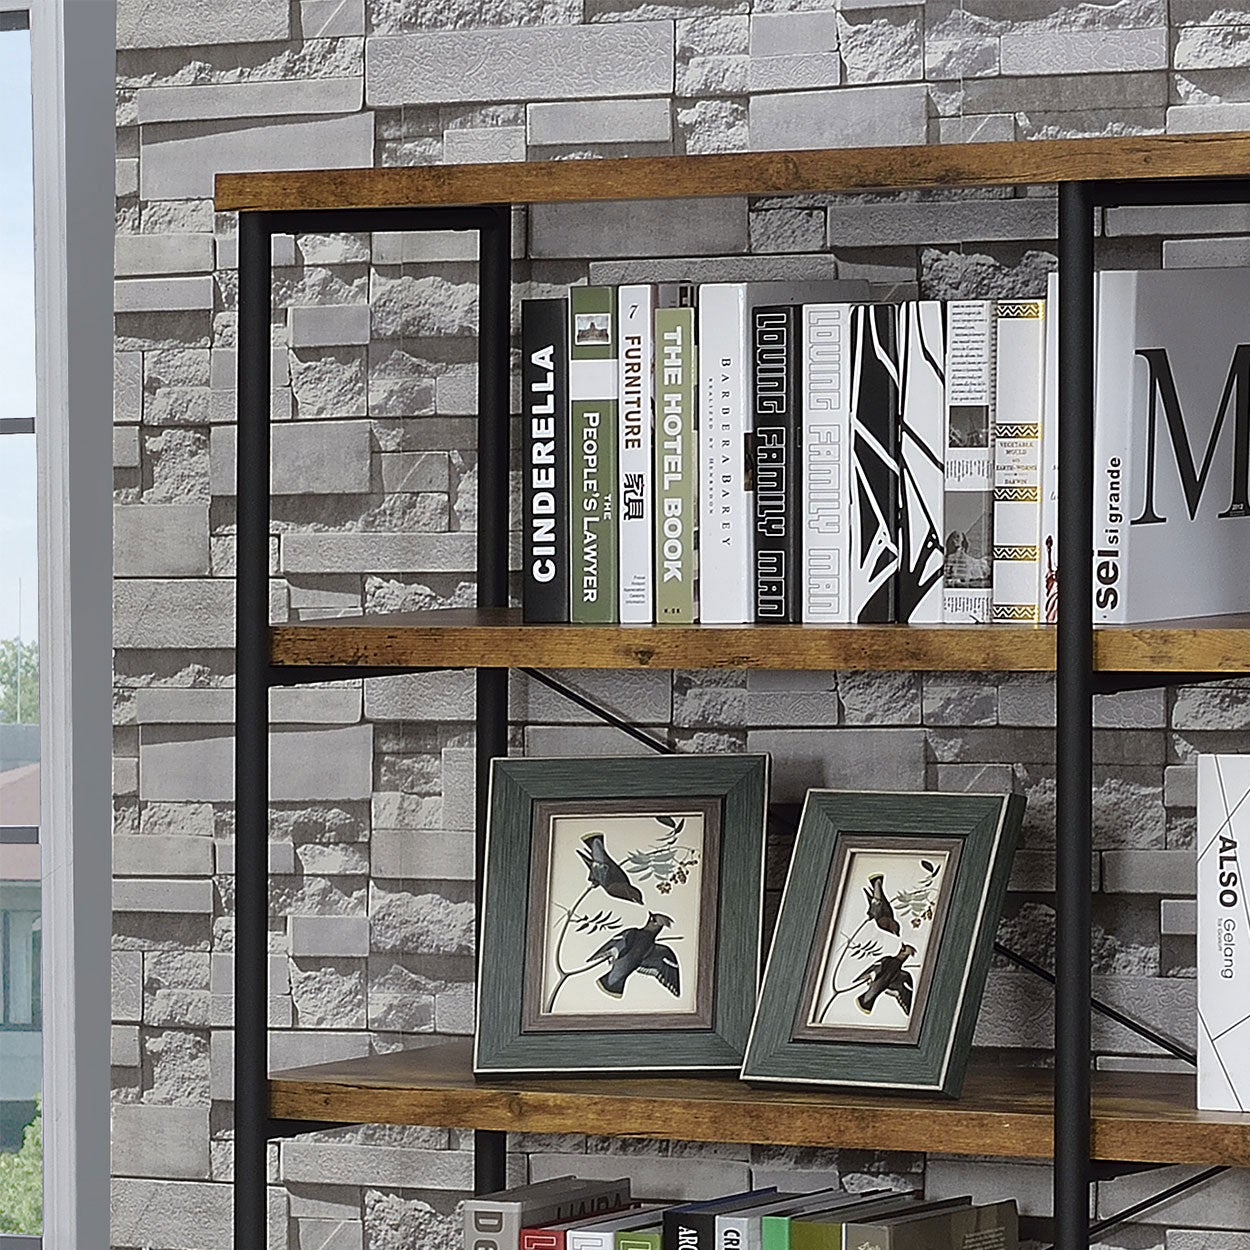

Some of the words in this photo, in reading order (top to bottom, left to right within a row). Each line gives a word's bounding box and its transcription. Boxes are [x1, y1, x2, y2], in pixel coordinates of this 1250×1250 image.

[624, 335, 641, 450] FURNITURE
[663, 325, 683, 386] THE
[530, 344, 556, 583] CINDERELLA
[582, 412, 601, 511] PEOPLE'S
[663, 393, 683, 491] HOTEL
[756, 426, 786, 537] FAMILY
[808, 424, 841, 534] FAMILY
[603, 494, 612, 520] THE
[663, 497, 683, 583] BOOK
[582, 516, 600, 602] LAWYER
[1218, 835, 1238, 908] ALSO
[1221, 917, 1237, 979] Gelang
